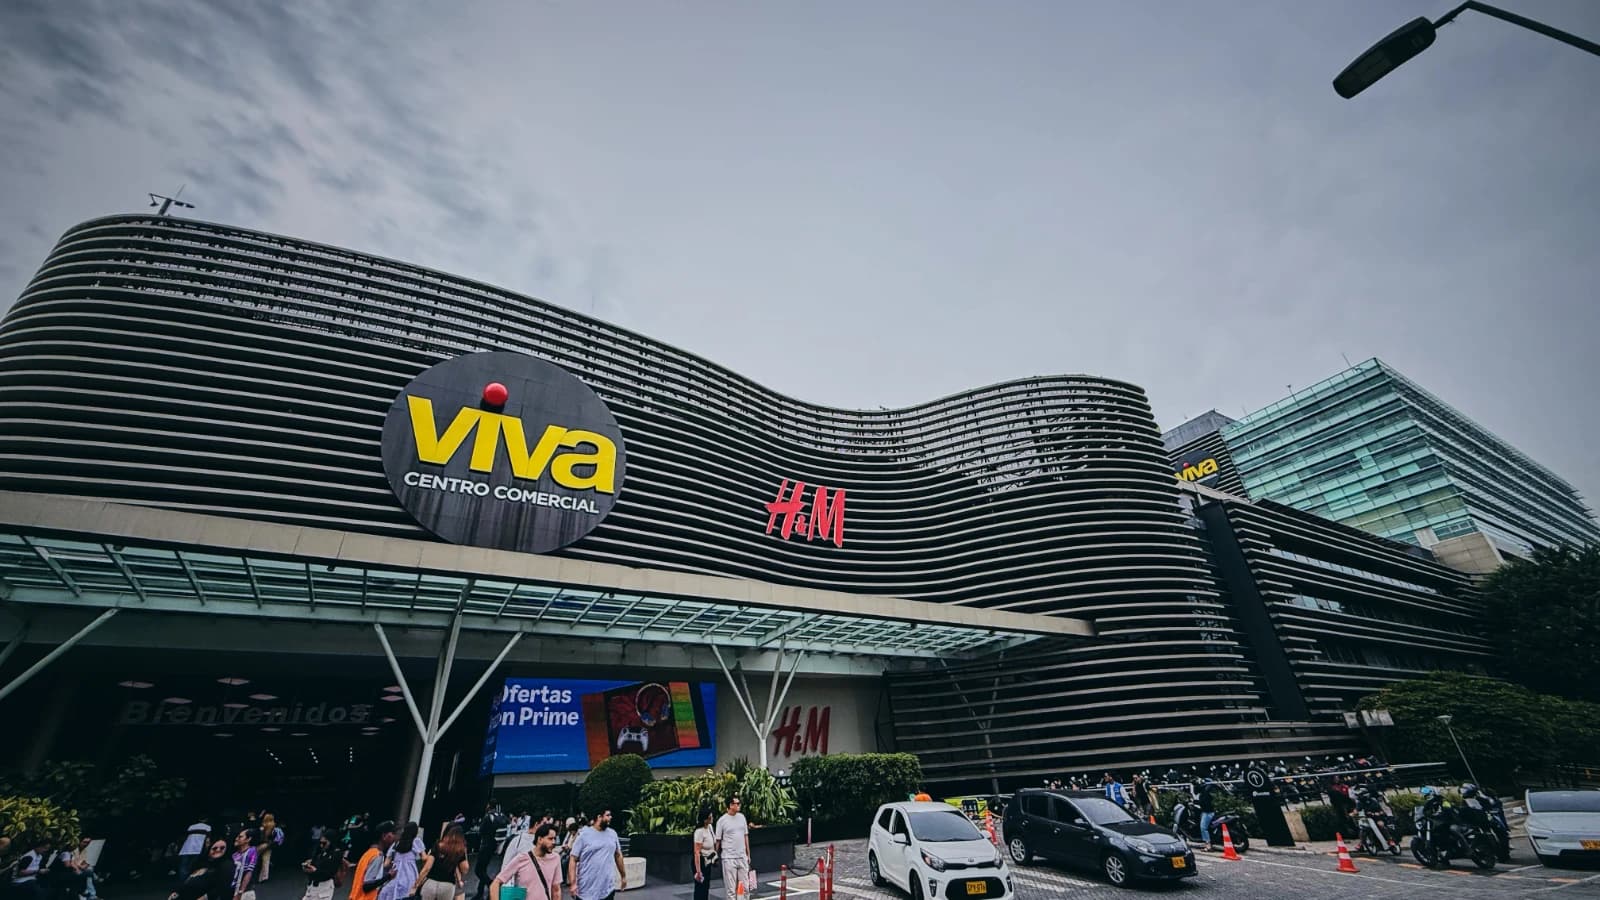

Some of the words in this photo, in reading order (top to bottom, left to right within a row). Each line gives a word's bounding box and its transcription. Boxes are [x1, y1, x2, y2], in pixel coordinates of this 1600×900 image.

[404, 471, 490, 497] CENTRO
[494, 484, 600, 514] COMERCIAL
[764, 477, 846, 548] H&M
[122, 700, 370, 725] Bienvenidos
[519, 706, 579, 726] Prime
[772, 705, 831, 758] H&M
